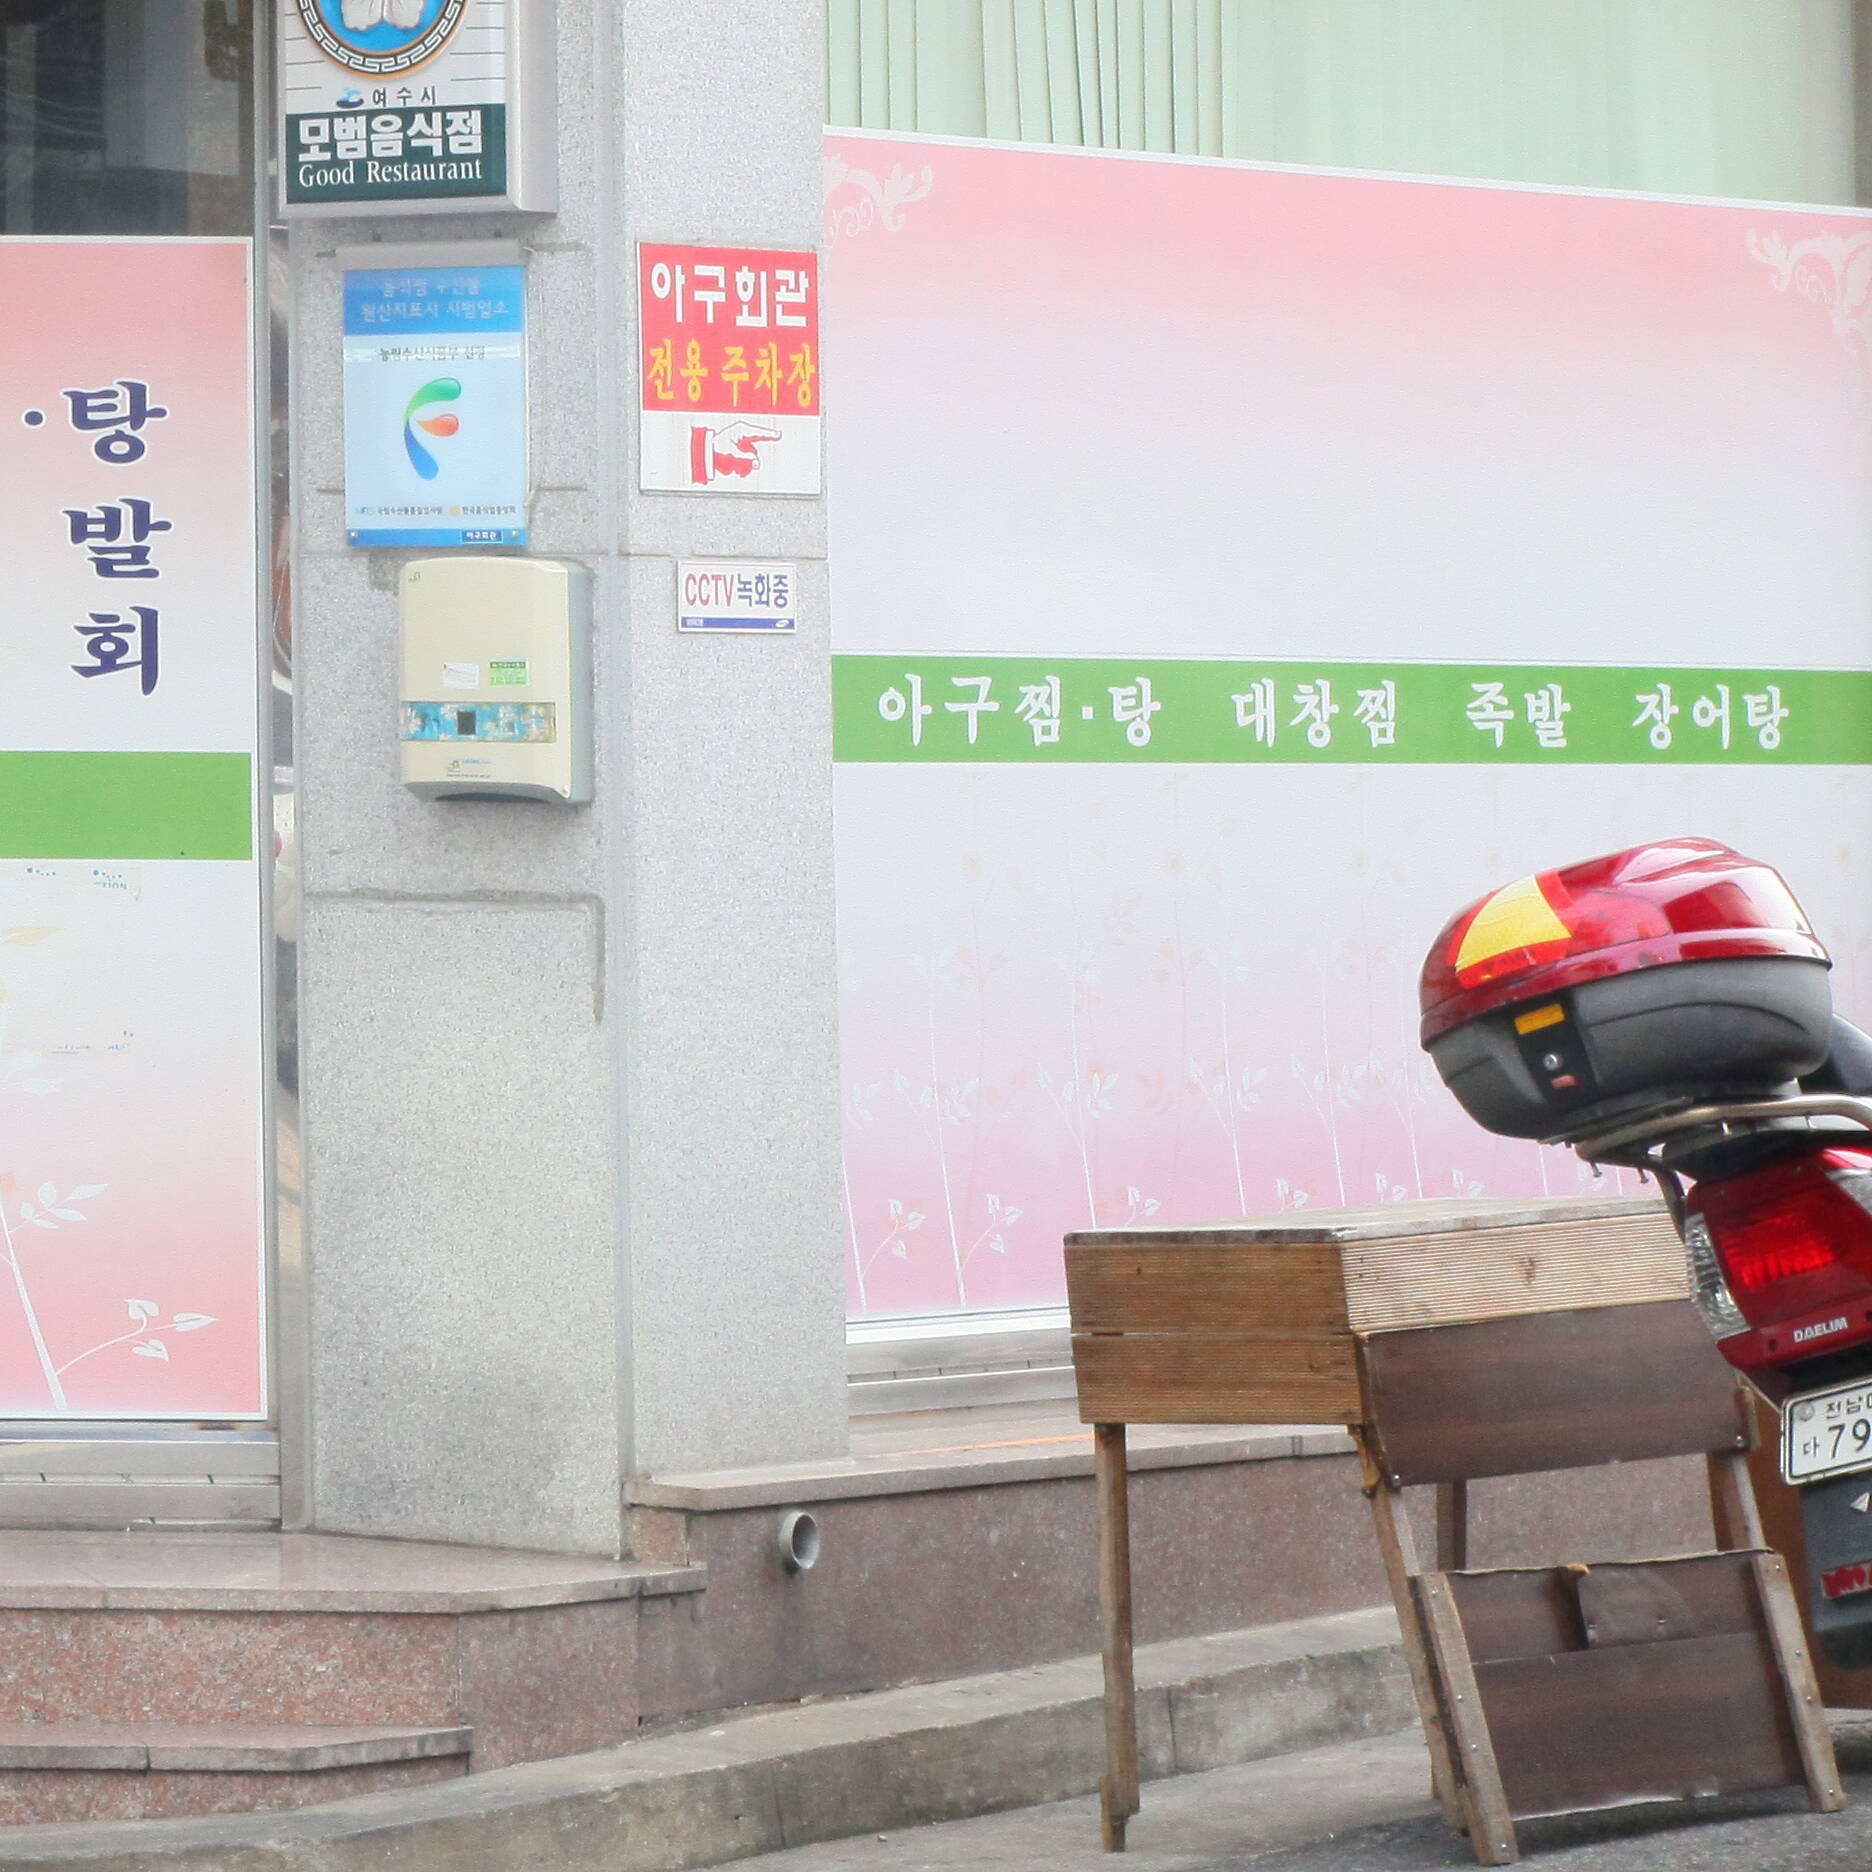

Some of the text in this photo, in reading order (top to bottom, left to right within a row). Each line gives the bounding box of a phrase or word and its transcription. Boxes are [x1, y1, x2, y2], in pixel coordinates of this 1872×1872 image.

[372, 86, 437, 108] 여수시
[298, 109, 483, 163] 모범음식점
[298, 158, 483, 188] Good Restaurant
[651, 262, 808, 328] 아구회관
[647, 338, 816, 408] 전용 주차장
[1235, 678, 1400, 749] 대창찜
[1465, 681, 1572, 749] 족발
[1632, 684, 1791, 753] 장어탕
[1793, 1317, 1848, 1342] DAELIM
[1826, 1393, 1872, 1419] 전남
